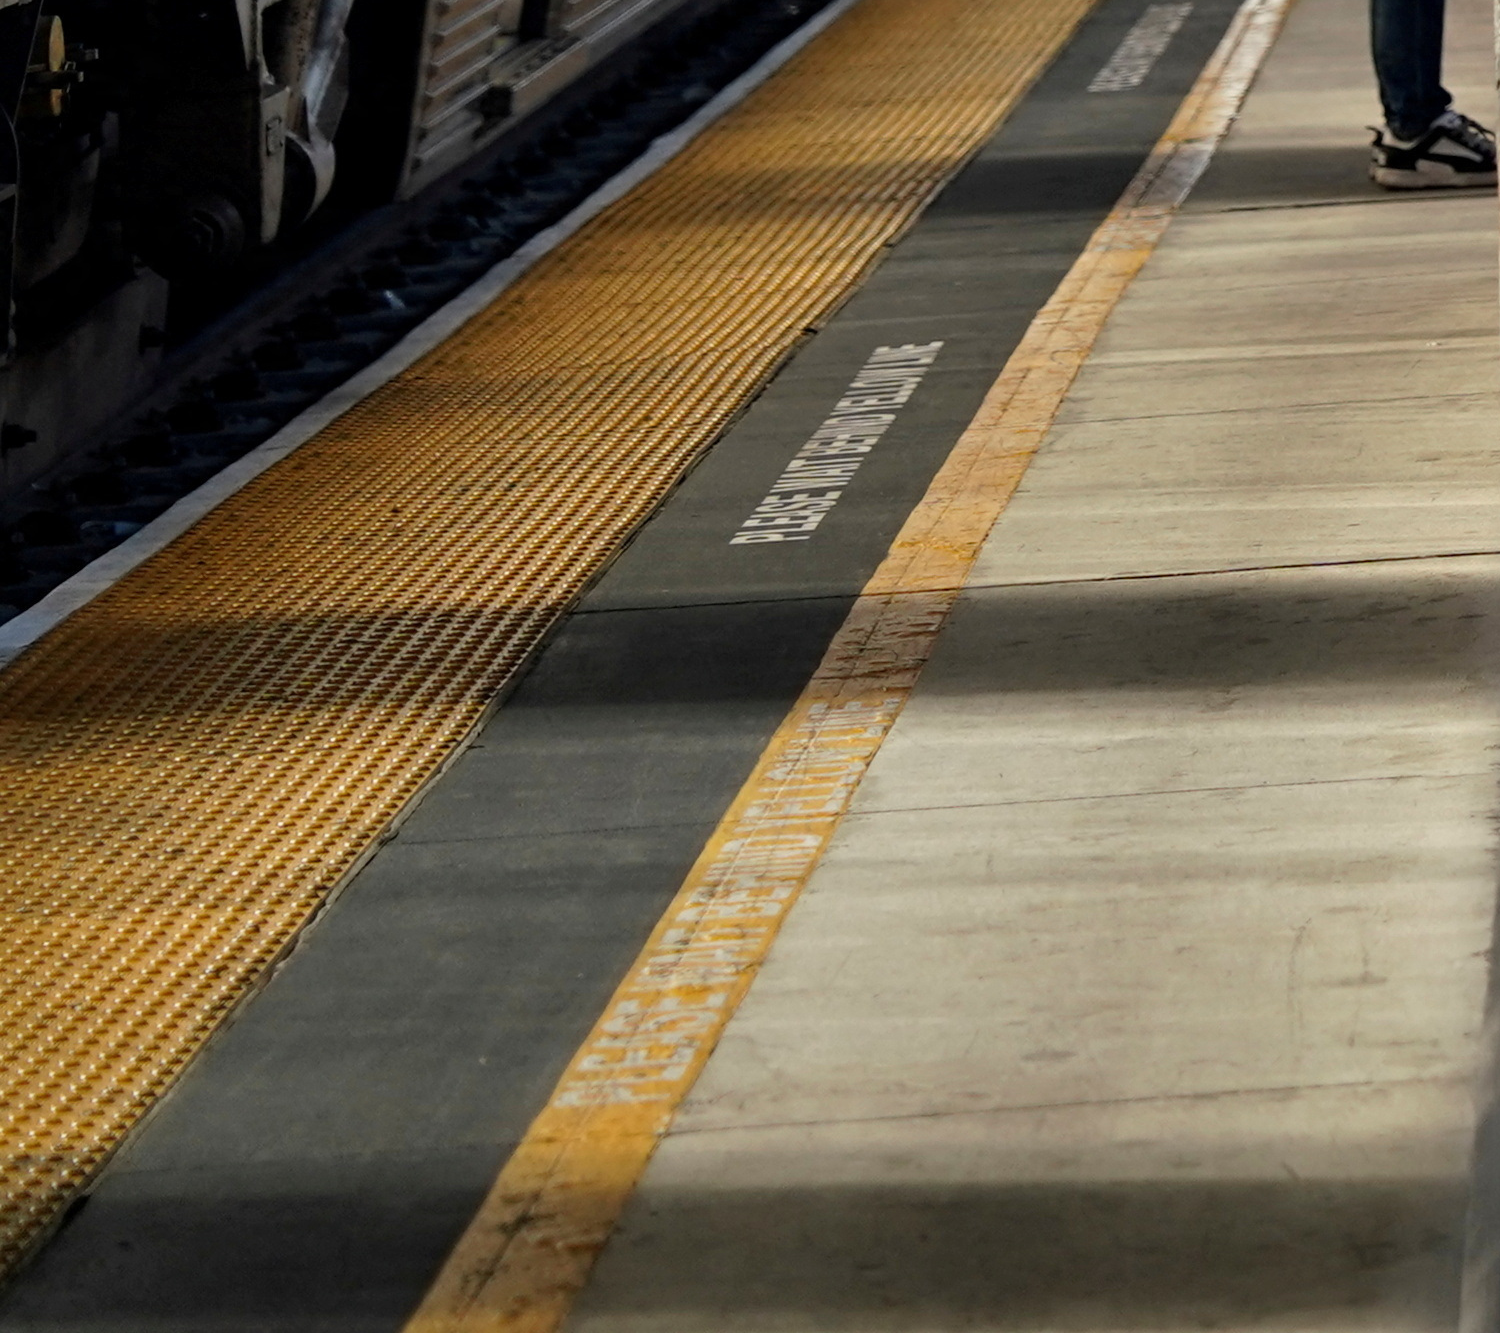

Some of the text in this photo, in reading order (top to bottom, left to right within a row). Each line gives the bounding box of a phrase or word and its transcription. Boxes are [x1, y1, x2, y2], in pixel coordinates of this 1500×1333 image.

[729, 340, 946, 546] PLEASE WAIT BEHIND YELLOW LINE
[735, 746, 873, 832] YELLOW
[676, 833, 824, 924] BEHIND
[553, 993, 728, 1109] PLEASE
